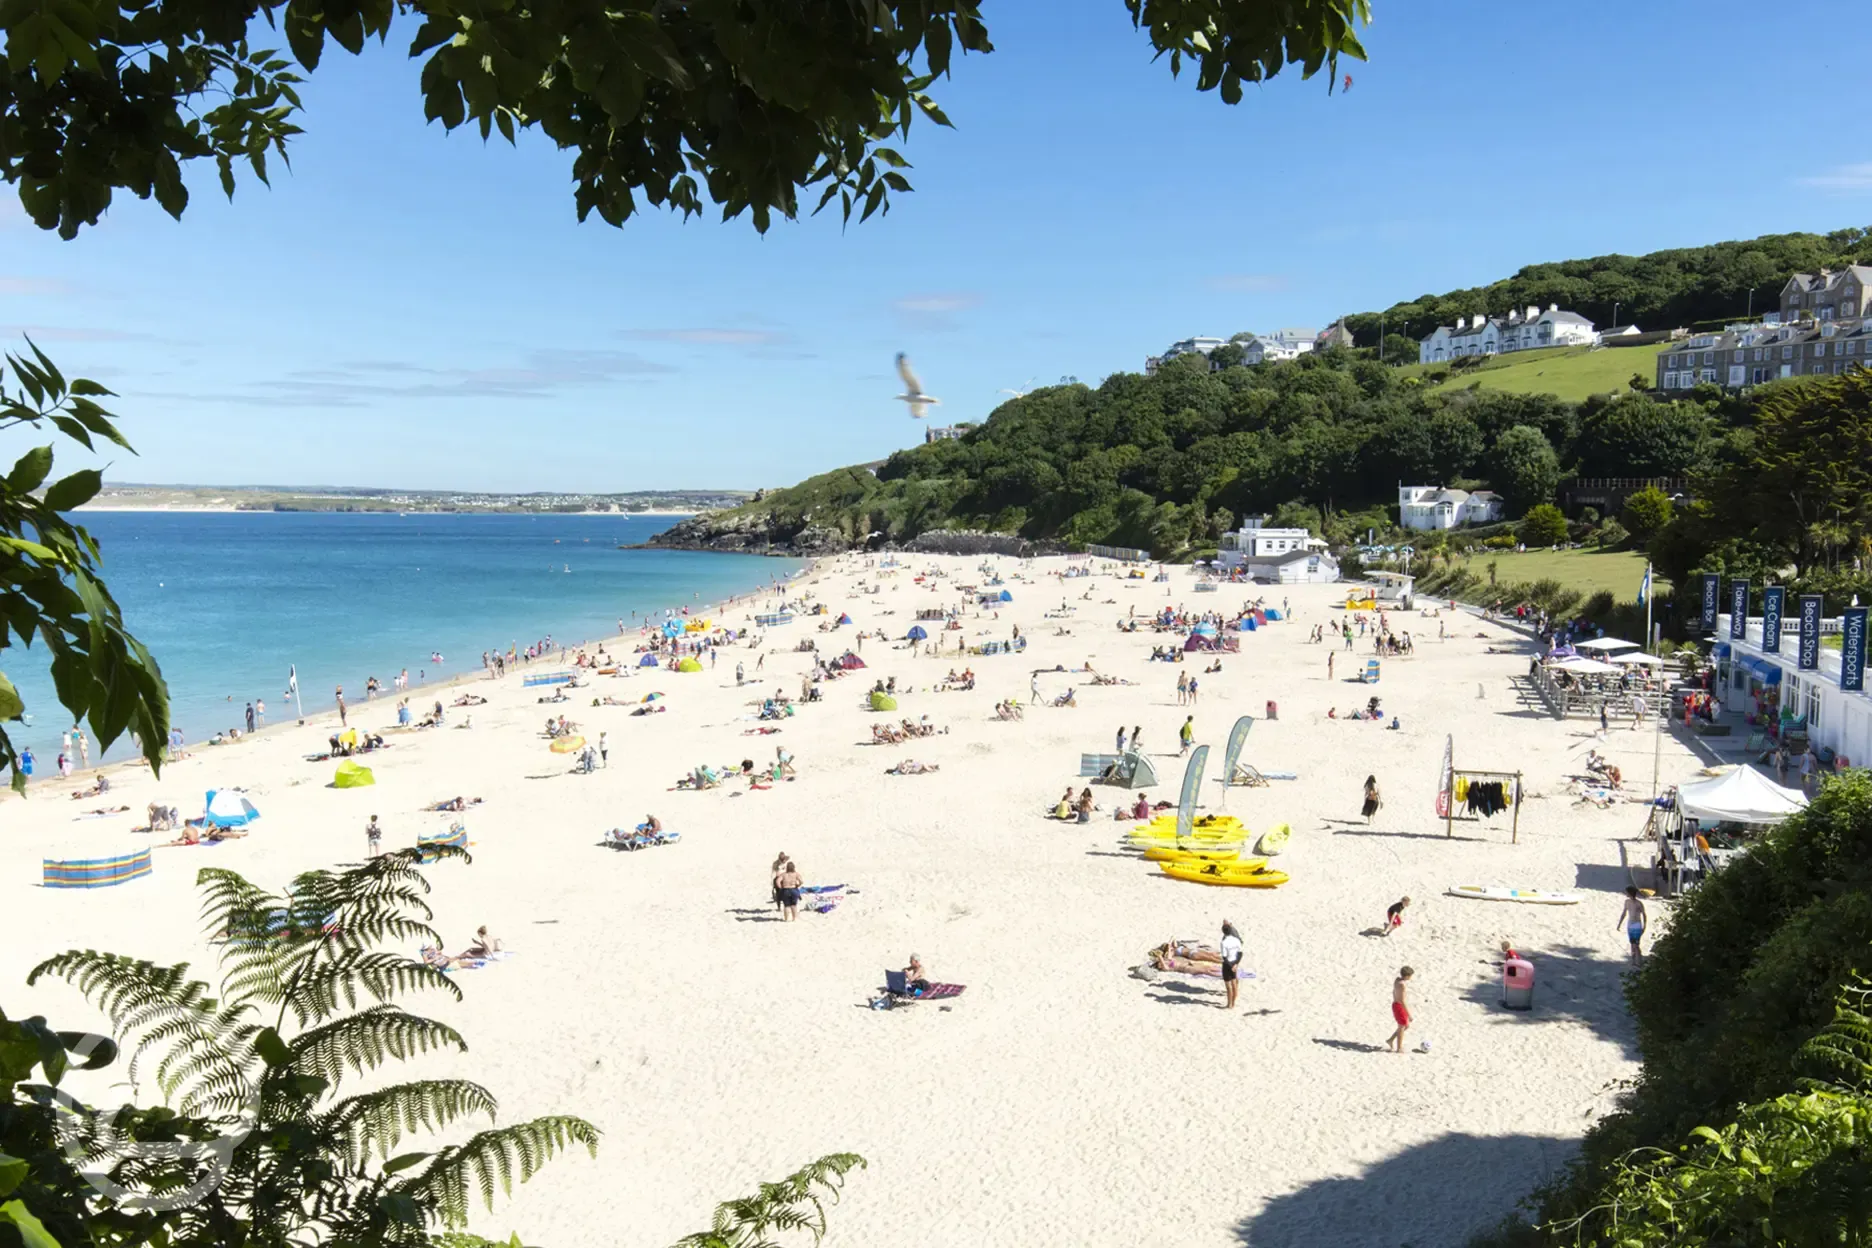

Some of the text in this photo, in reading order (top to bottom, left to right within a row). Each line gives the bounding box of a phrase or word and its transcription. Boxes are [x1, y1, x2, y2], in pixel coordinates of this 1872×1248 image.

[1705, 580, 1715, 623] Beach Bar
[1733, 586, 1745, 636] Take-Away
[1767, 595, 1779, 647] Ice Cream
[1803, 601, 1816, 666] Beach Shop
[1846, 615, 1862, 686] Watersports
